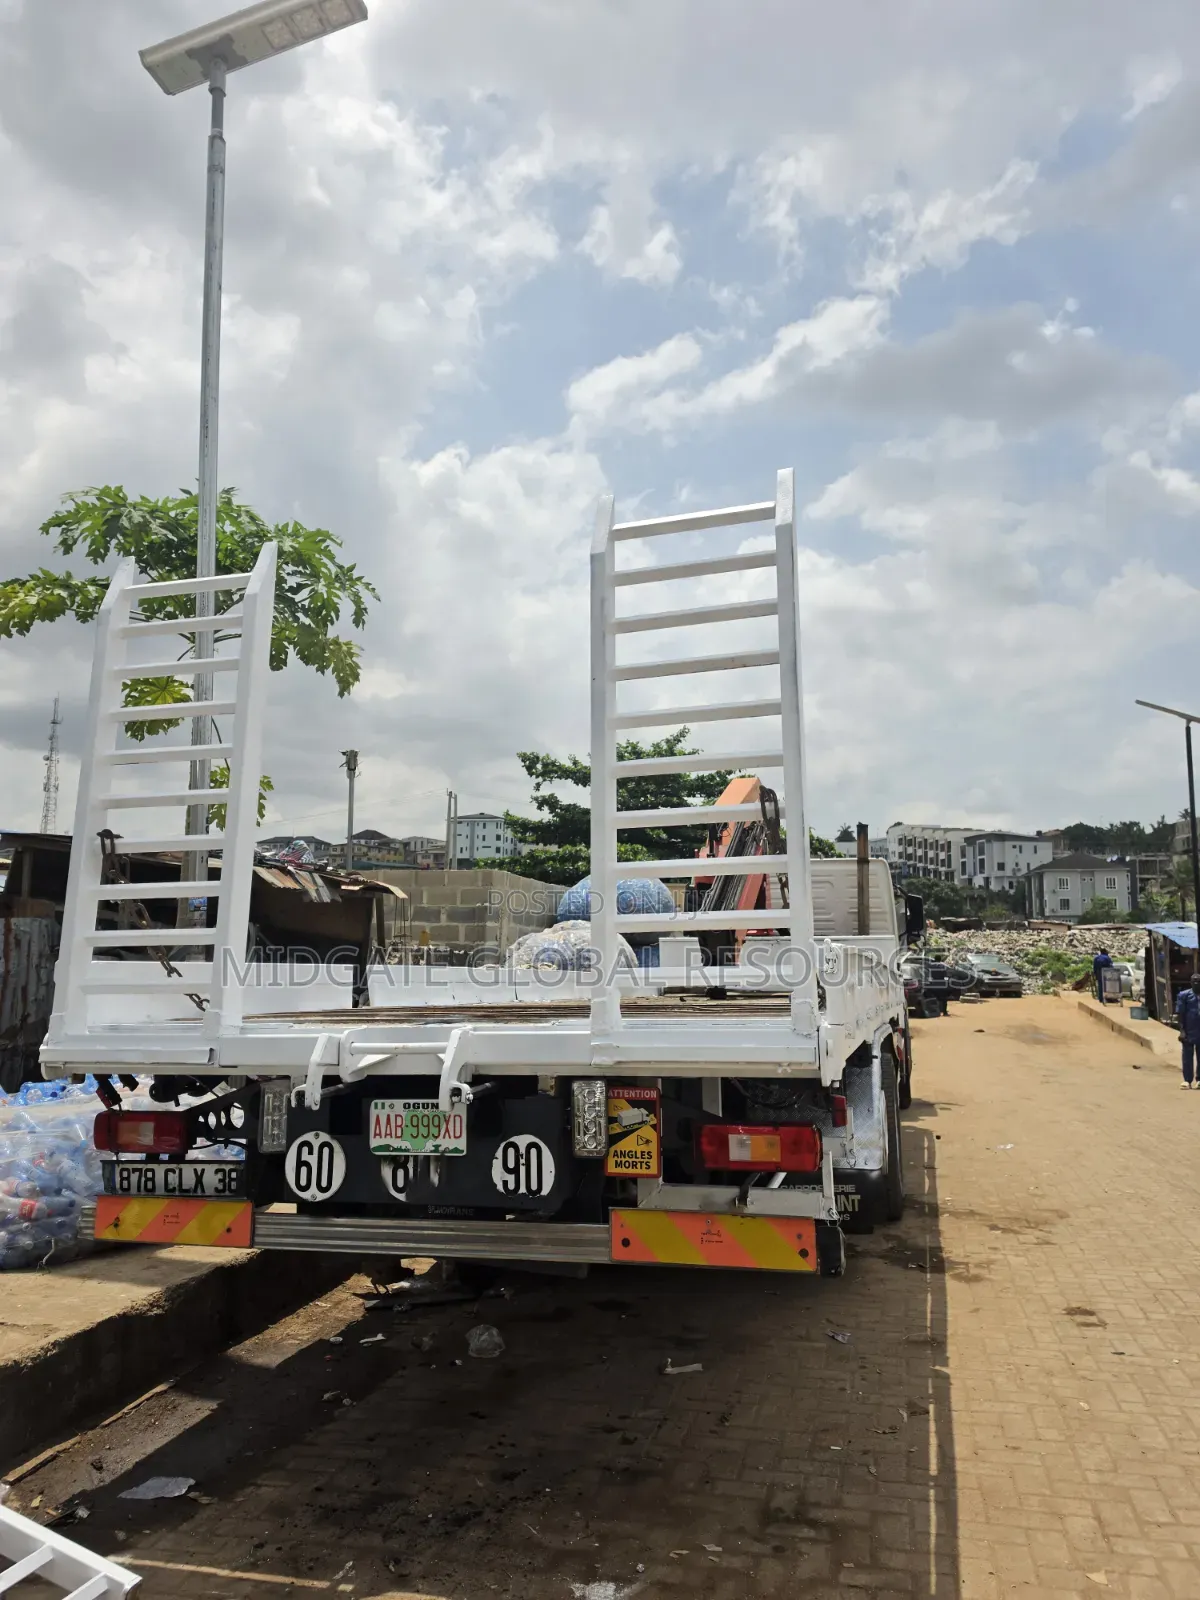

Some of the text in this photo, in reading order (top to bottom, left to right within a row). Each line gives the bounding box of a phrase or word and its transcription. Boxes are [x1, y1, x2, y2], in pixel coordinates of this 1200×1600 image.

[608, 1089, 657, 1098] ATTENTION
[403, 1102, 439, 1110] OGUN
[612, 1150, 653, 1159] ANGLES
[295, 1140, 334, 1193] 60
[502, 1141, 543, 1197] 90
[614, 1161, 651, 1170] MORTS
[119, 1167, 238, 1194] 878 CLX 38
